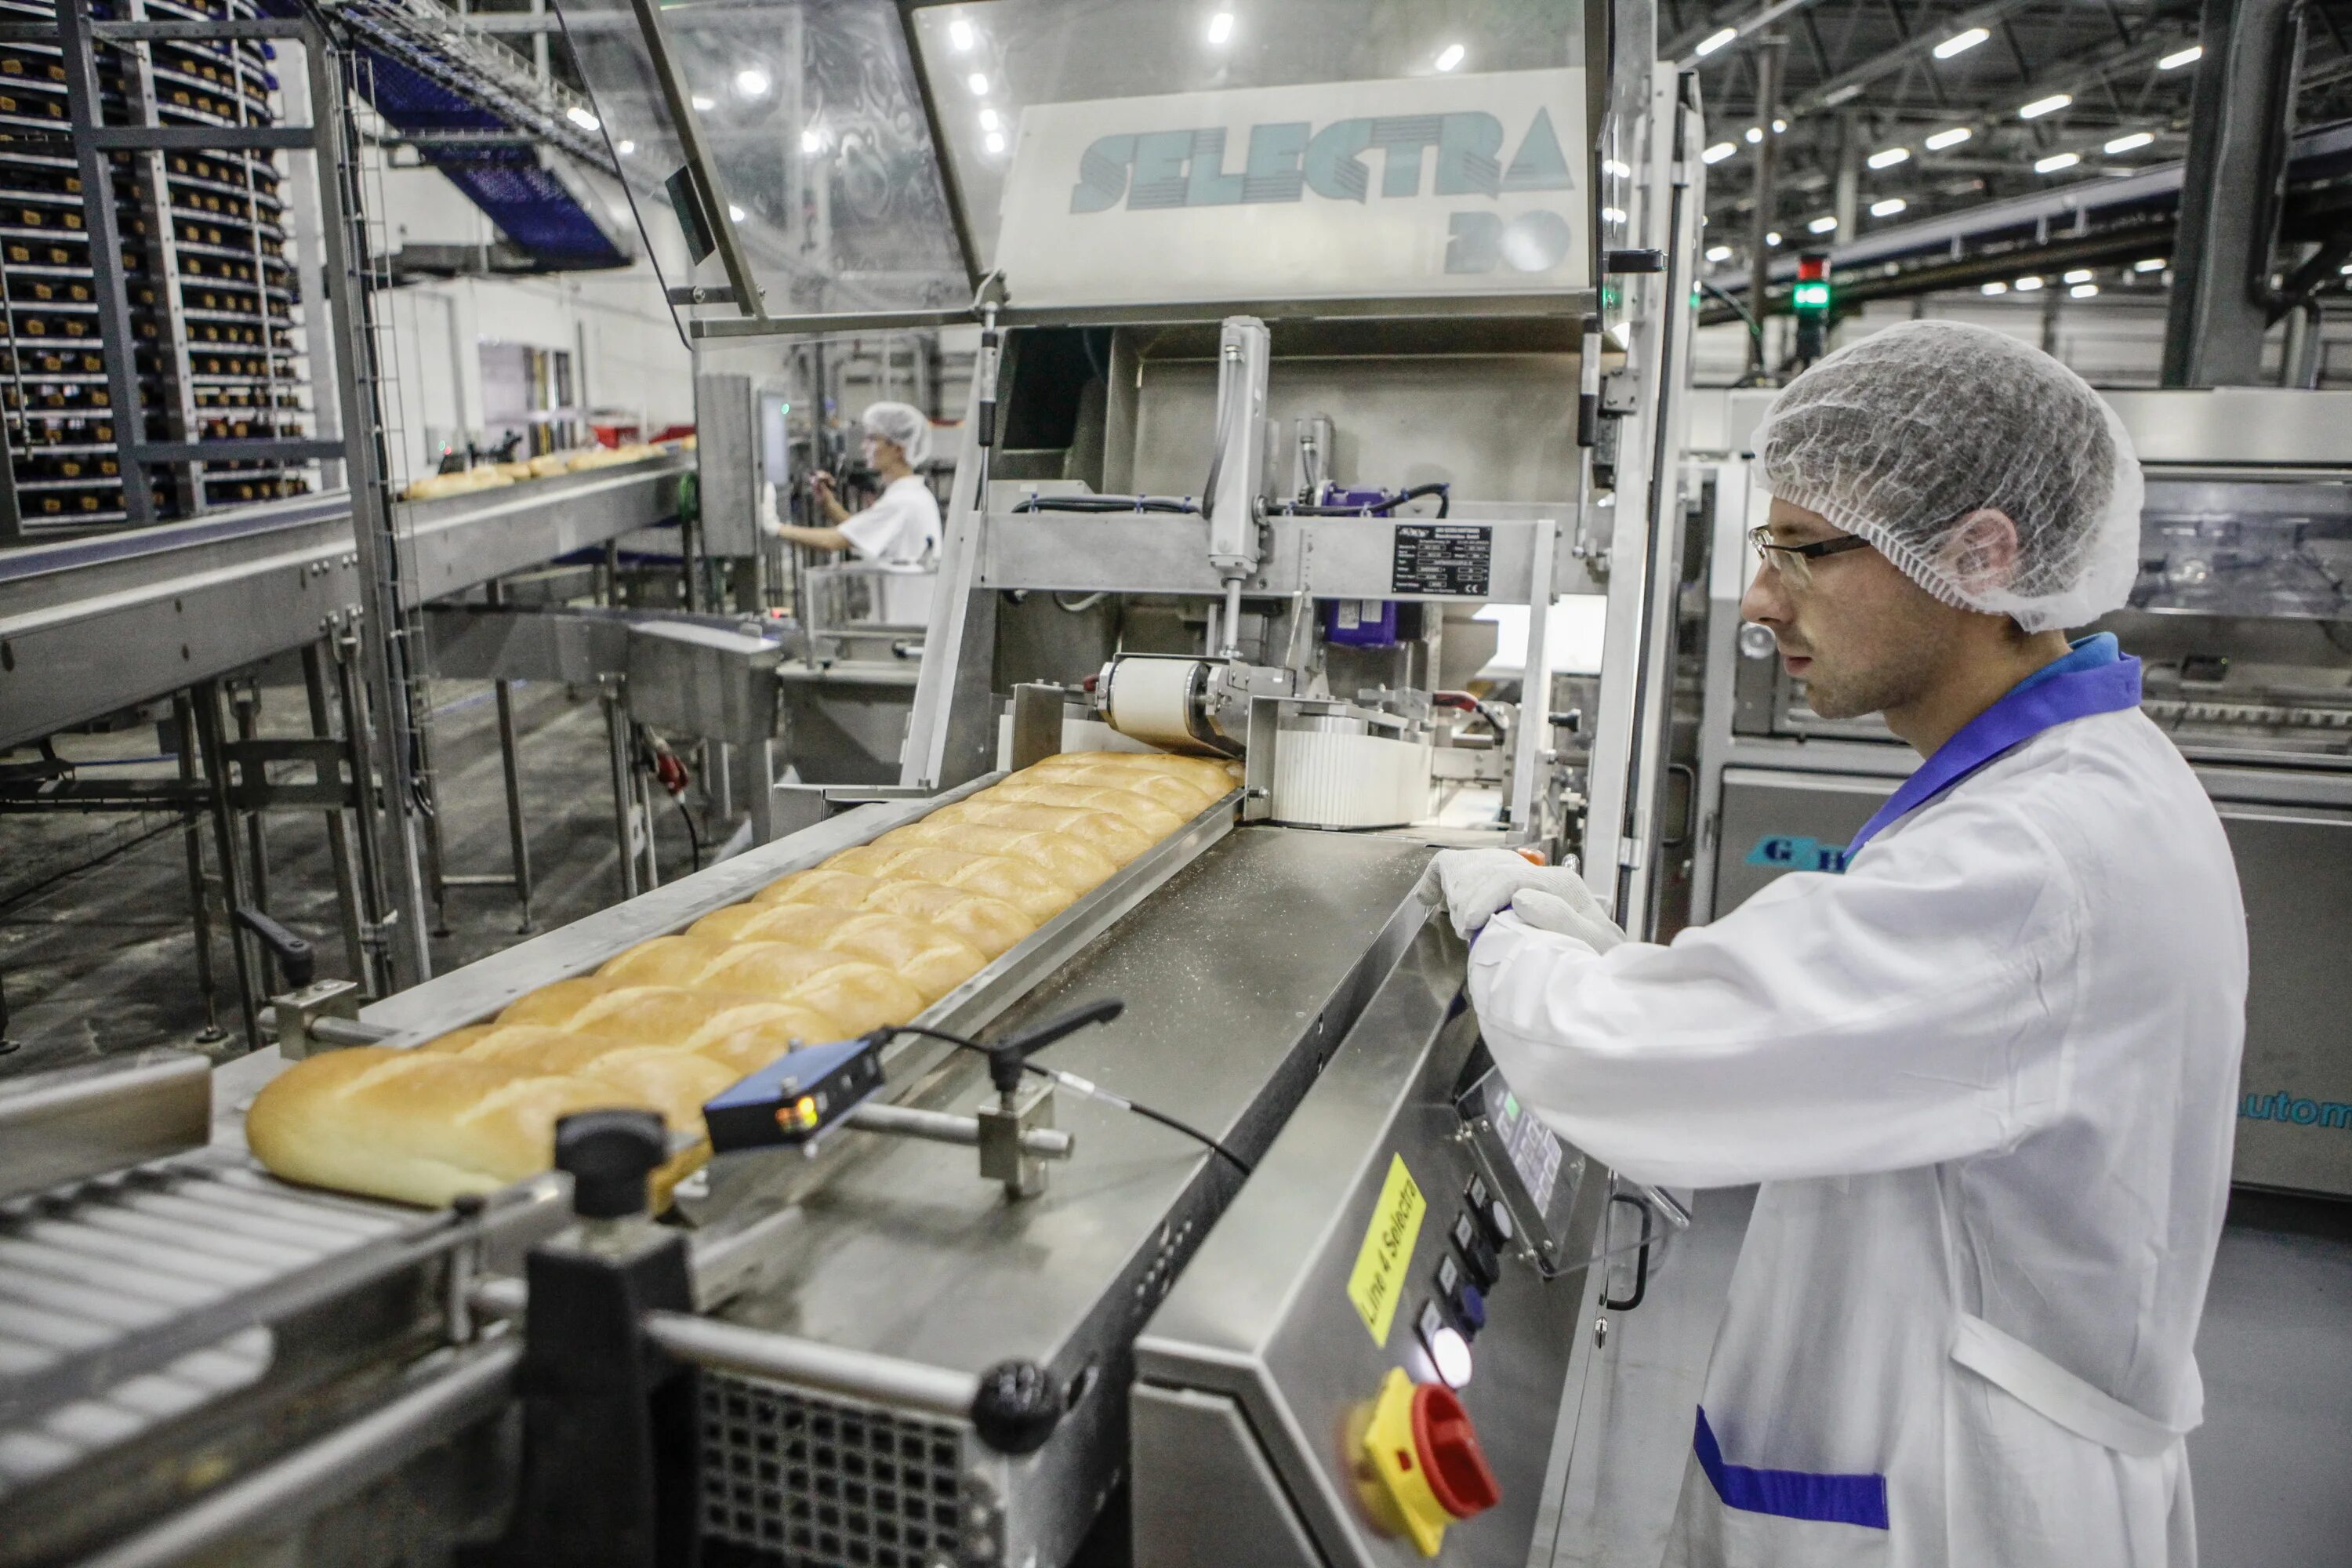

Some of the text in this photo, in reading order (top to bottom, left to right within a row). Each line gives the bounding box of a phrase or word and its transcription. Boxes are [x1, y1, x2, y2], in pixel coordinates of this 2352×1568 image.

[1069, 105, 1576, 215] SELECTRA
[2237, 1091, 2352, 1130] utom
[1361, 1178, 1416, 1326] Line 4 Selectra
